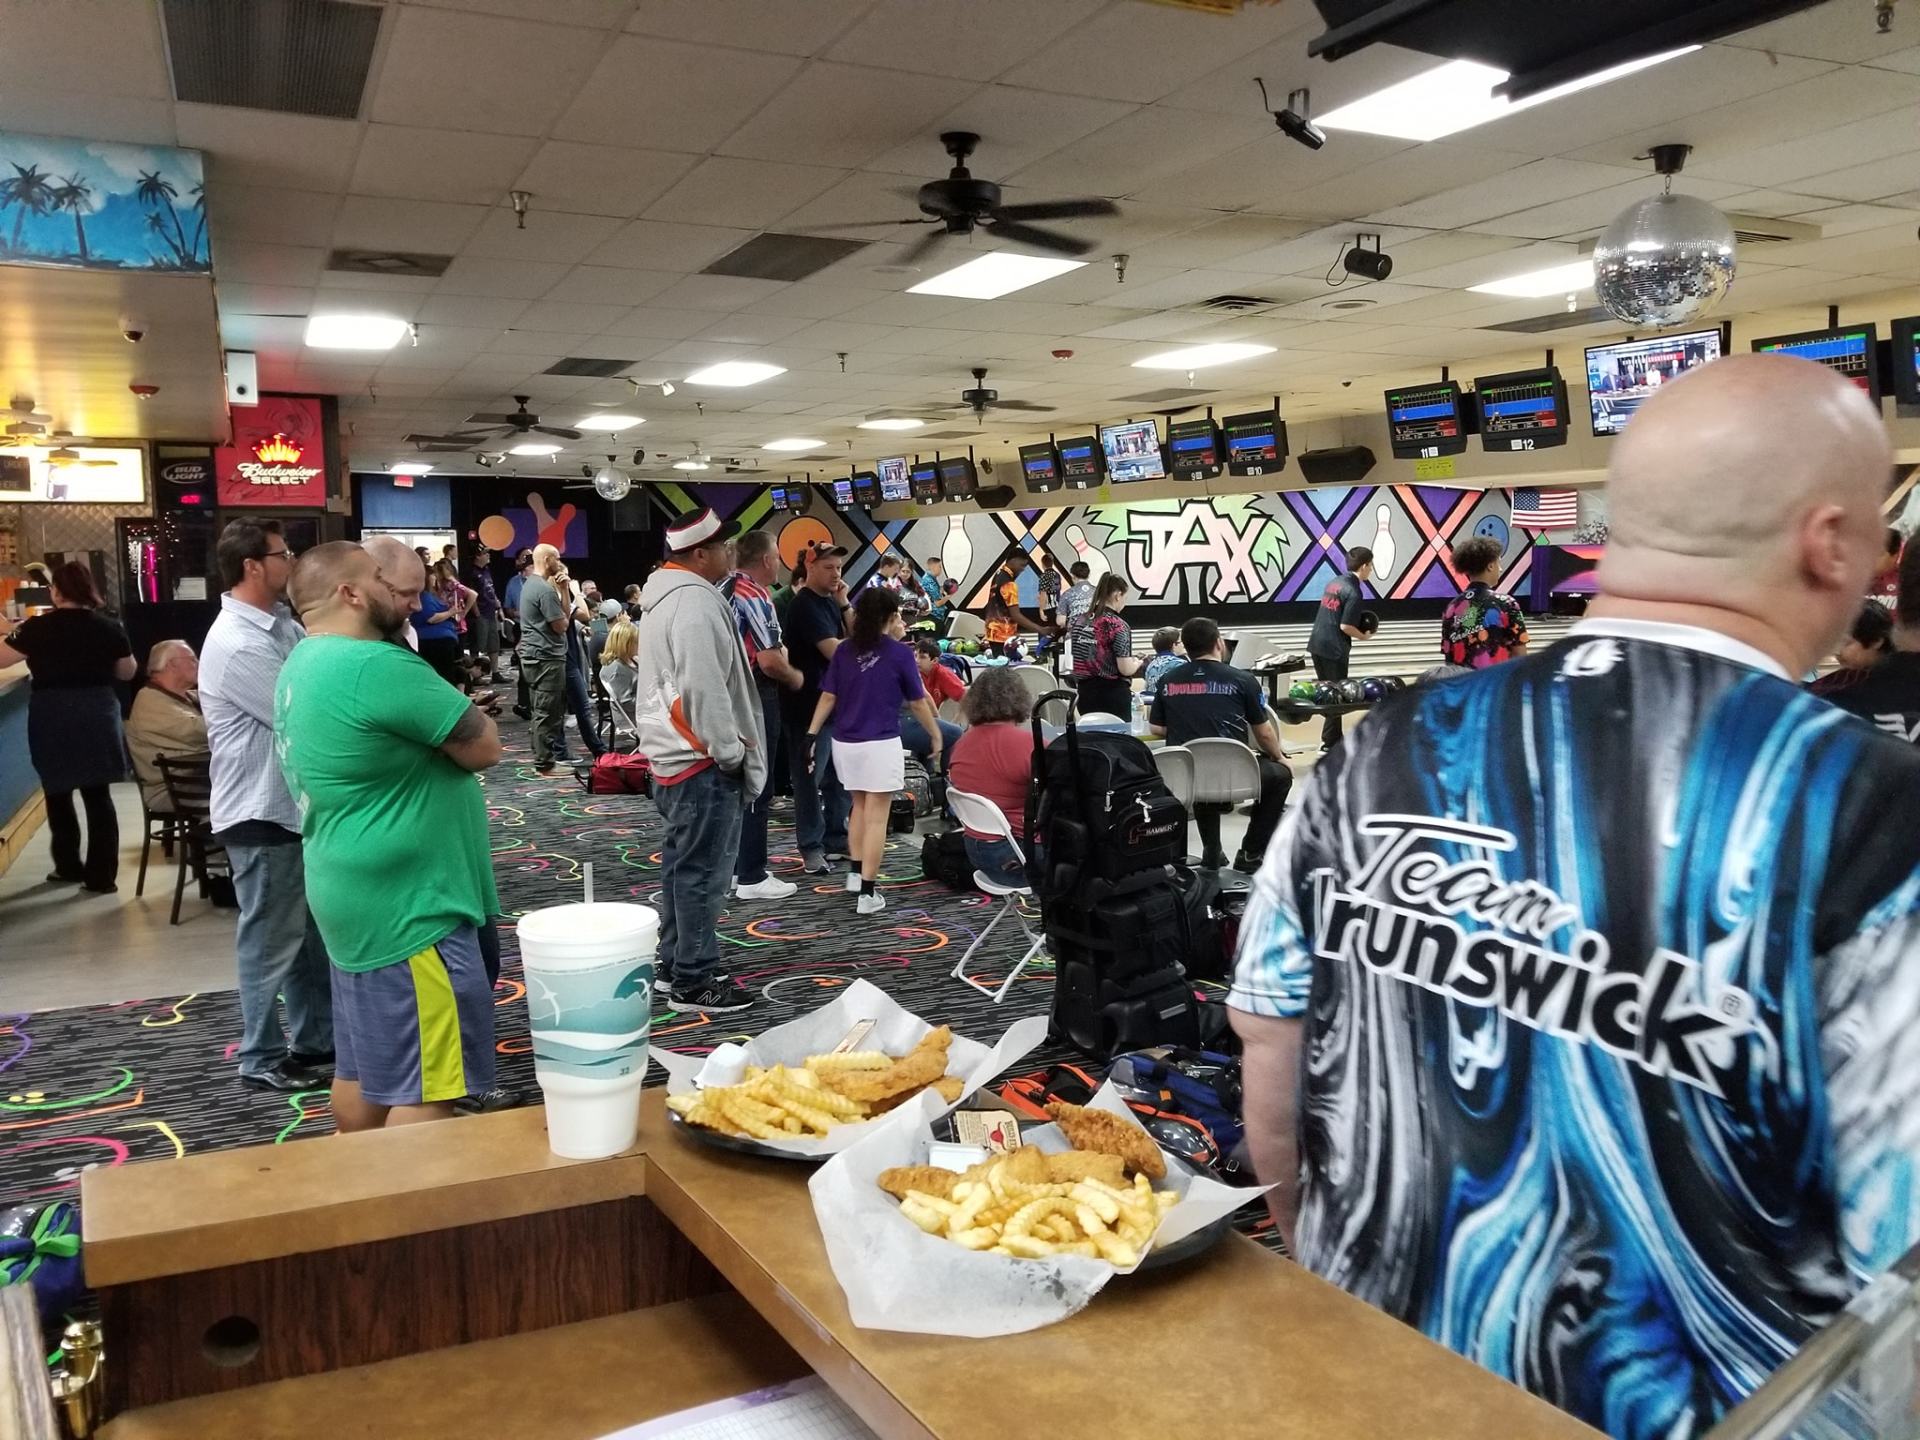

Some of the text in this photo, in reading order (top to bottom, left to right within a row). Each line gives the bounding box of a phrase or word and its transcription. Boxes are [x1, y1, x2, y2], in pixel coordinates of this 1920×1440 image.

[1522, 439, 1535, 451] 12
[1420, 448, 1429, 459] 11
[174, 465, 202, 473] BUD
[237, 462, 323, 478] Budweiser
[168, 472, 207, 481] LIGHT
[250, 476, 311, 485] SELECT
[1125, 499, 1274, 604] JAX
[1146, 824, 1173, 837] HAMMER
[1346, 813, 1582, 940] Team
[1314, 868, 1746, 1099] runswick
